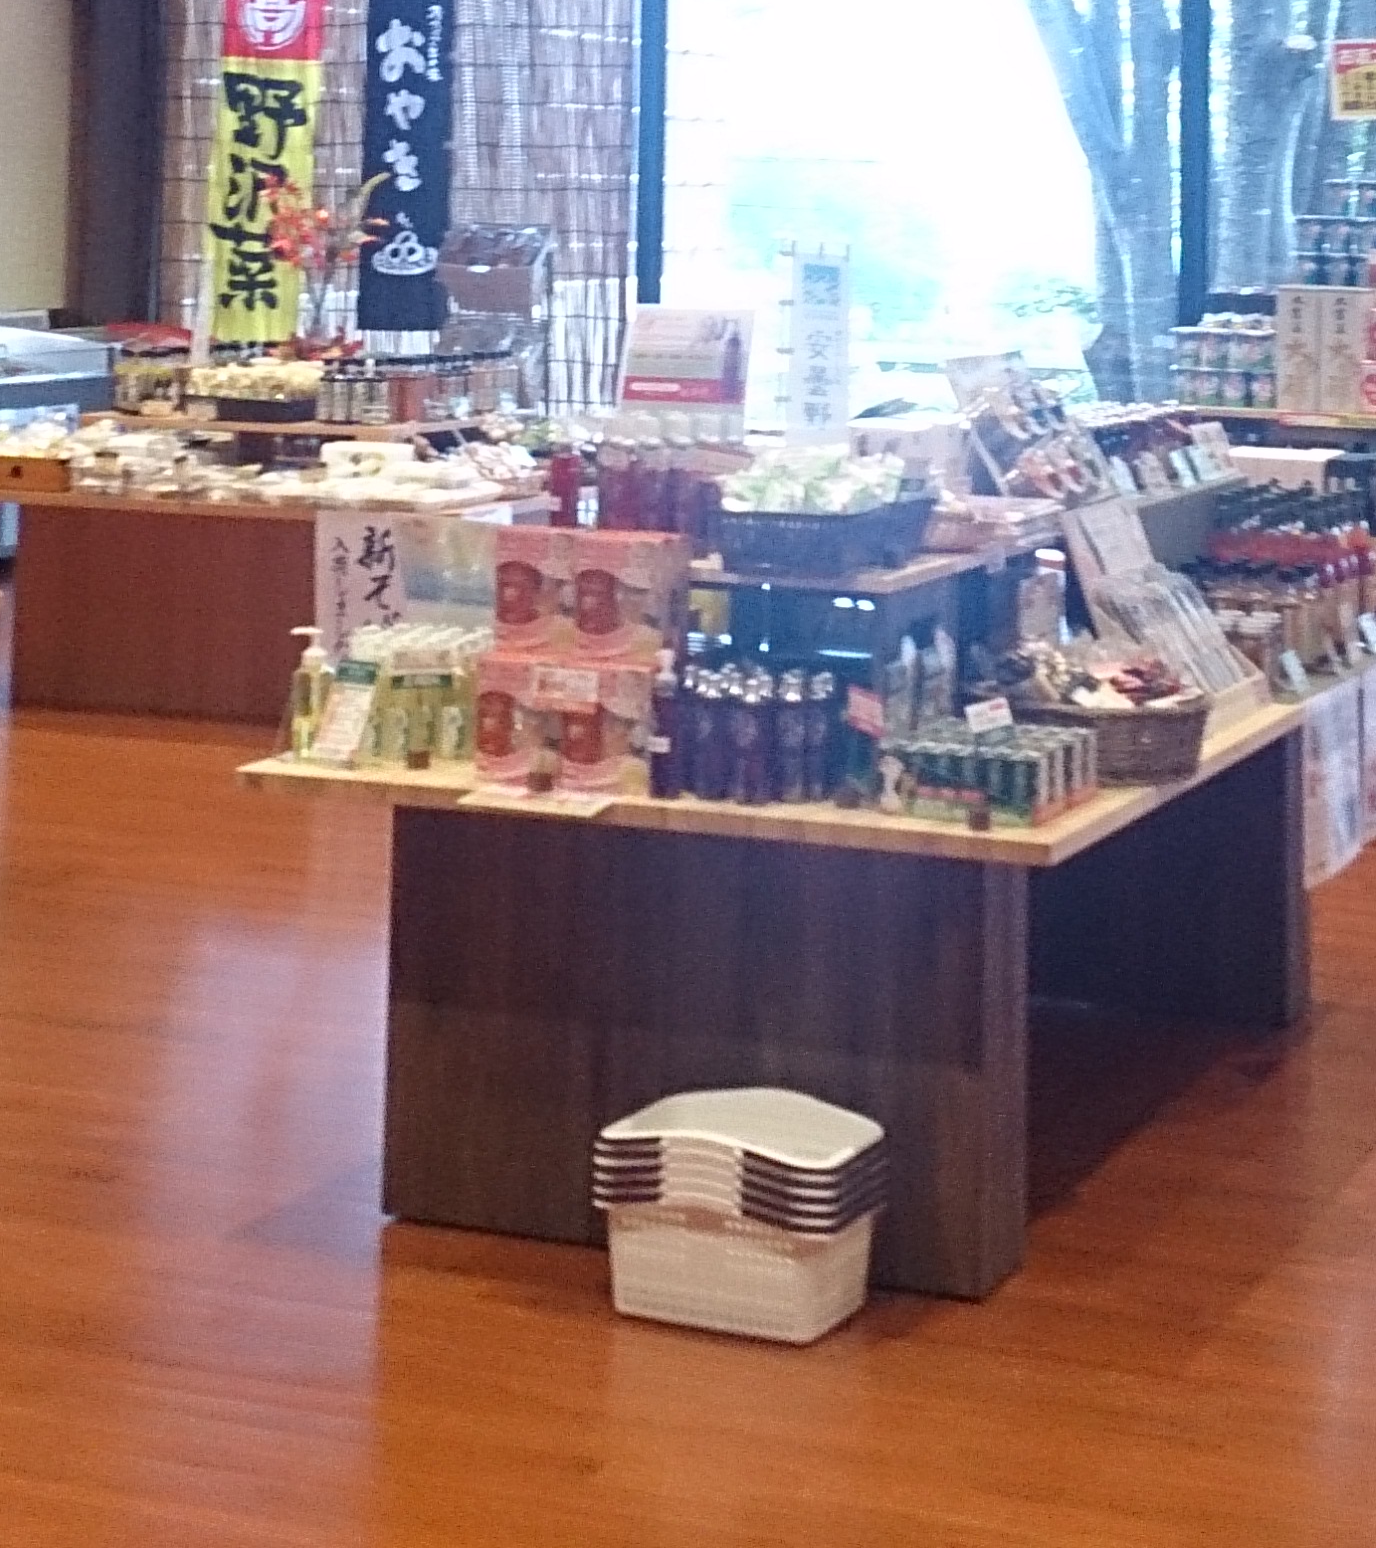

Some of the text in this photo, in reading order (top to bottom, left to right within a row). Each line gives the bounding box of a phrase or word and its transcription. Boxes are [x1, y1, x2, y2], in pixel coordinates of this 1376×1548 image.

[210, 71, 307, 312] 野沢菜
[376, 18, 426, 192] おやき
